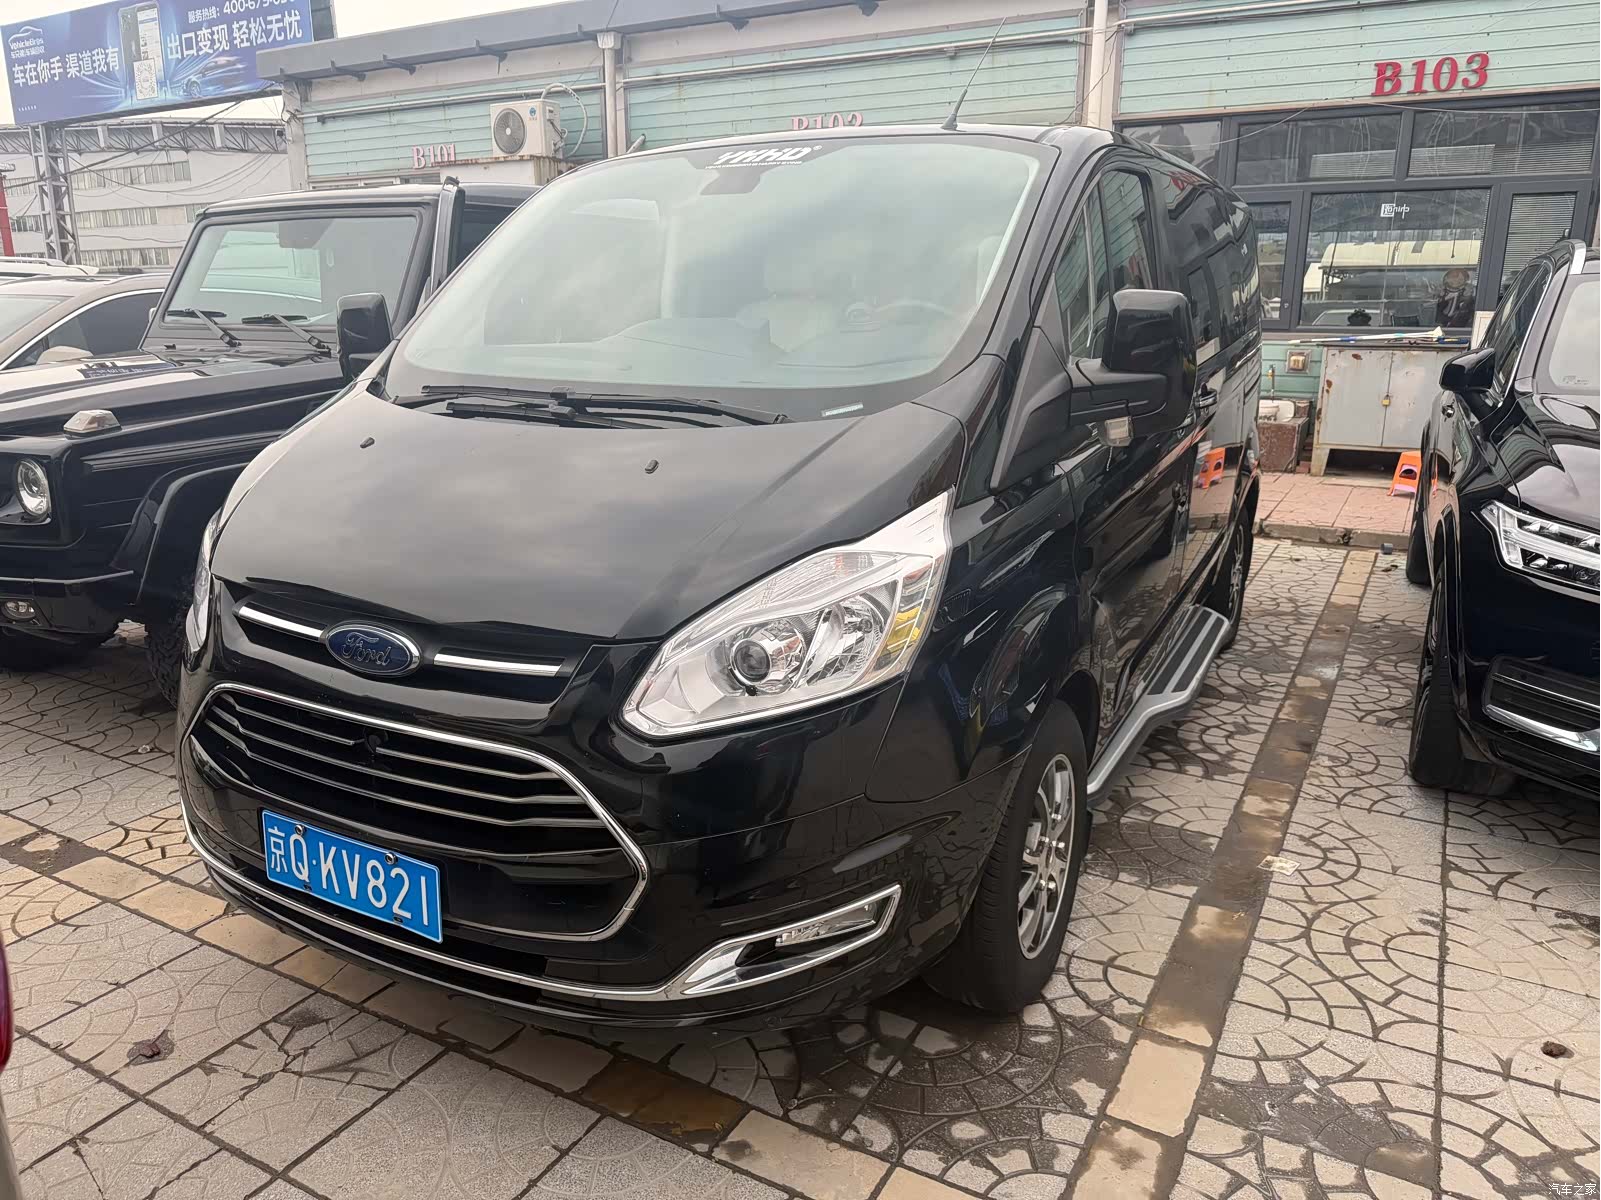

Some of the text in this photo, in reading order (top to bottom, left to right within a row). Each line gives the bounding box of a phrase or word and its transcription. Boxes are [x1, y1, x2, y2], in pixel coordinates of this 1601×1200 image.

[167, 24, 230, 59] 出口变现
[232, 10, 303, 49] 轻松无忧
[12, 56, 64, 87] 车在你手
[65, 47, 120, 79] 渠道我有
[1371, 53, 1490, 97] B103
[412, 144, 457, 169] B101
[341, 631, 392, 666] Ford
[267, 825, 429, 926] 京Q·KV821
